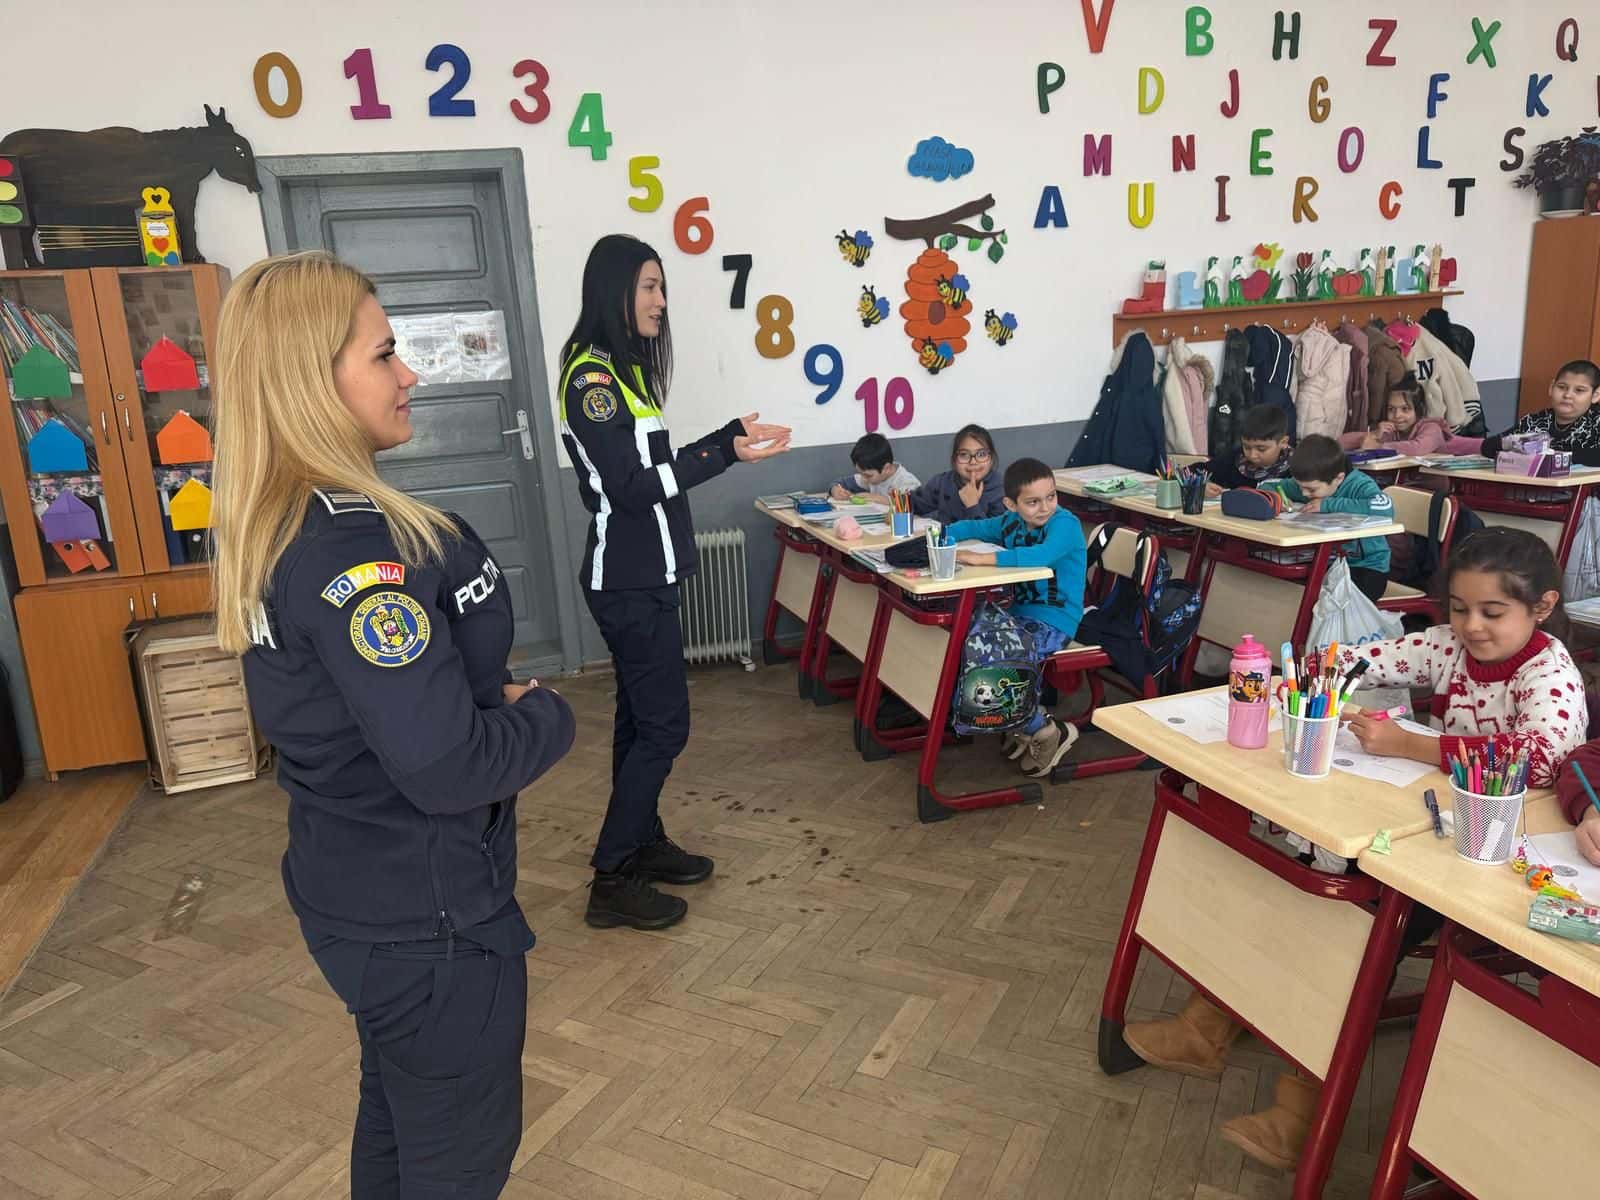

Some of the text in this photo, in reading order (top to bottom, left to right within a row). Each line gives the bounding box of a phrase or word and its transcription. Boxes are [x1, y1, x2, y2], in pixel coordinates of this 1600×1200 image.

[1081, 0, 1578, 67] V B H Z X Q
[1038, 63, 1065, 113] P
[1138, 67, 1165, 114] D
[1221, 70, 1239, 118] J
[1309, 76, 1330, 123] G
[1427, 74, 1449, 118] F
[1526, 74, 1552, 117] K
[1084, 126, 1525, 176] M N E O L S
[1034, 176, 1475, 229] A U I R C T
[253, 44, 914, 432] 0 1 2 3 4 5 6 7 8 9 10
[1416, 357, 1434, 381] N
